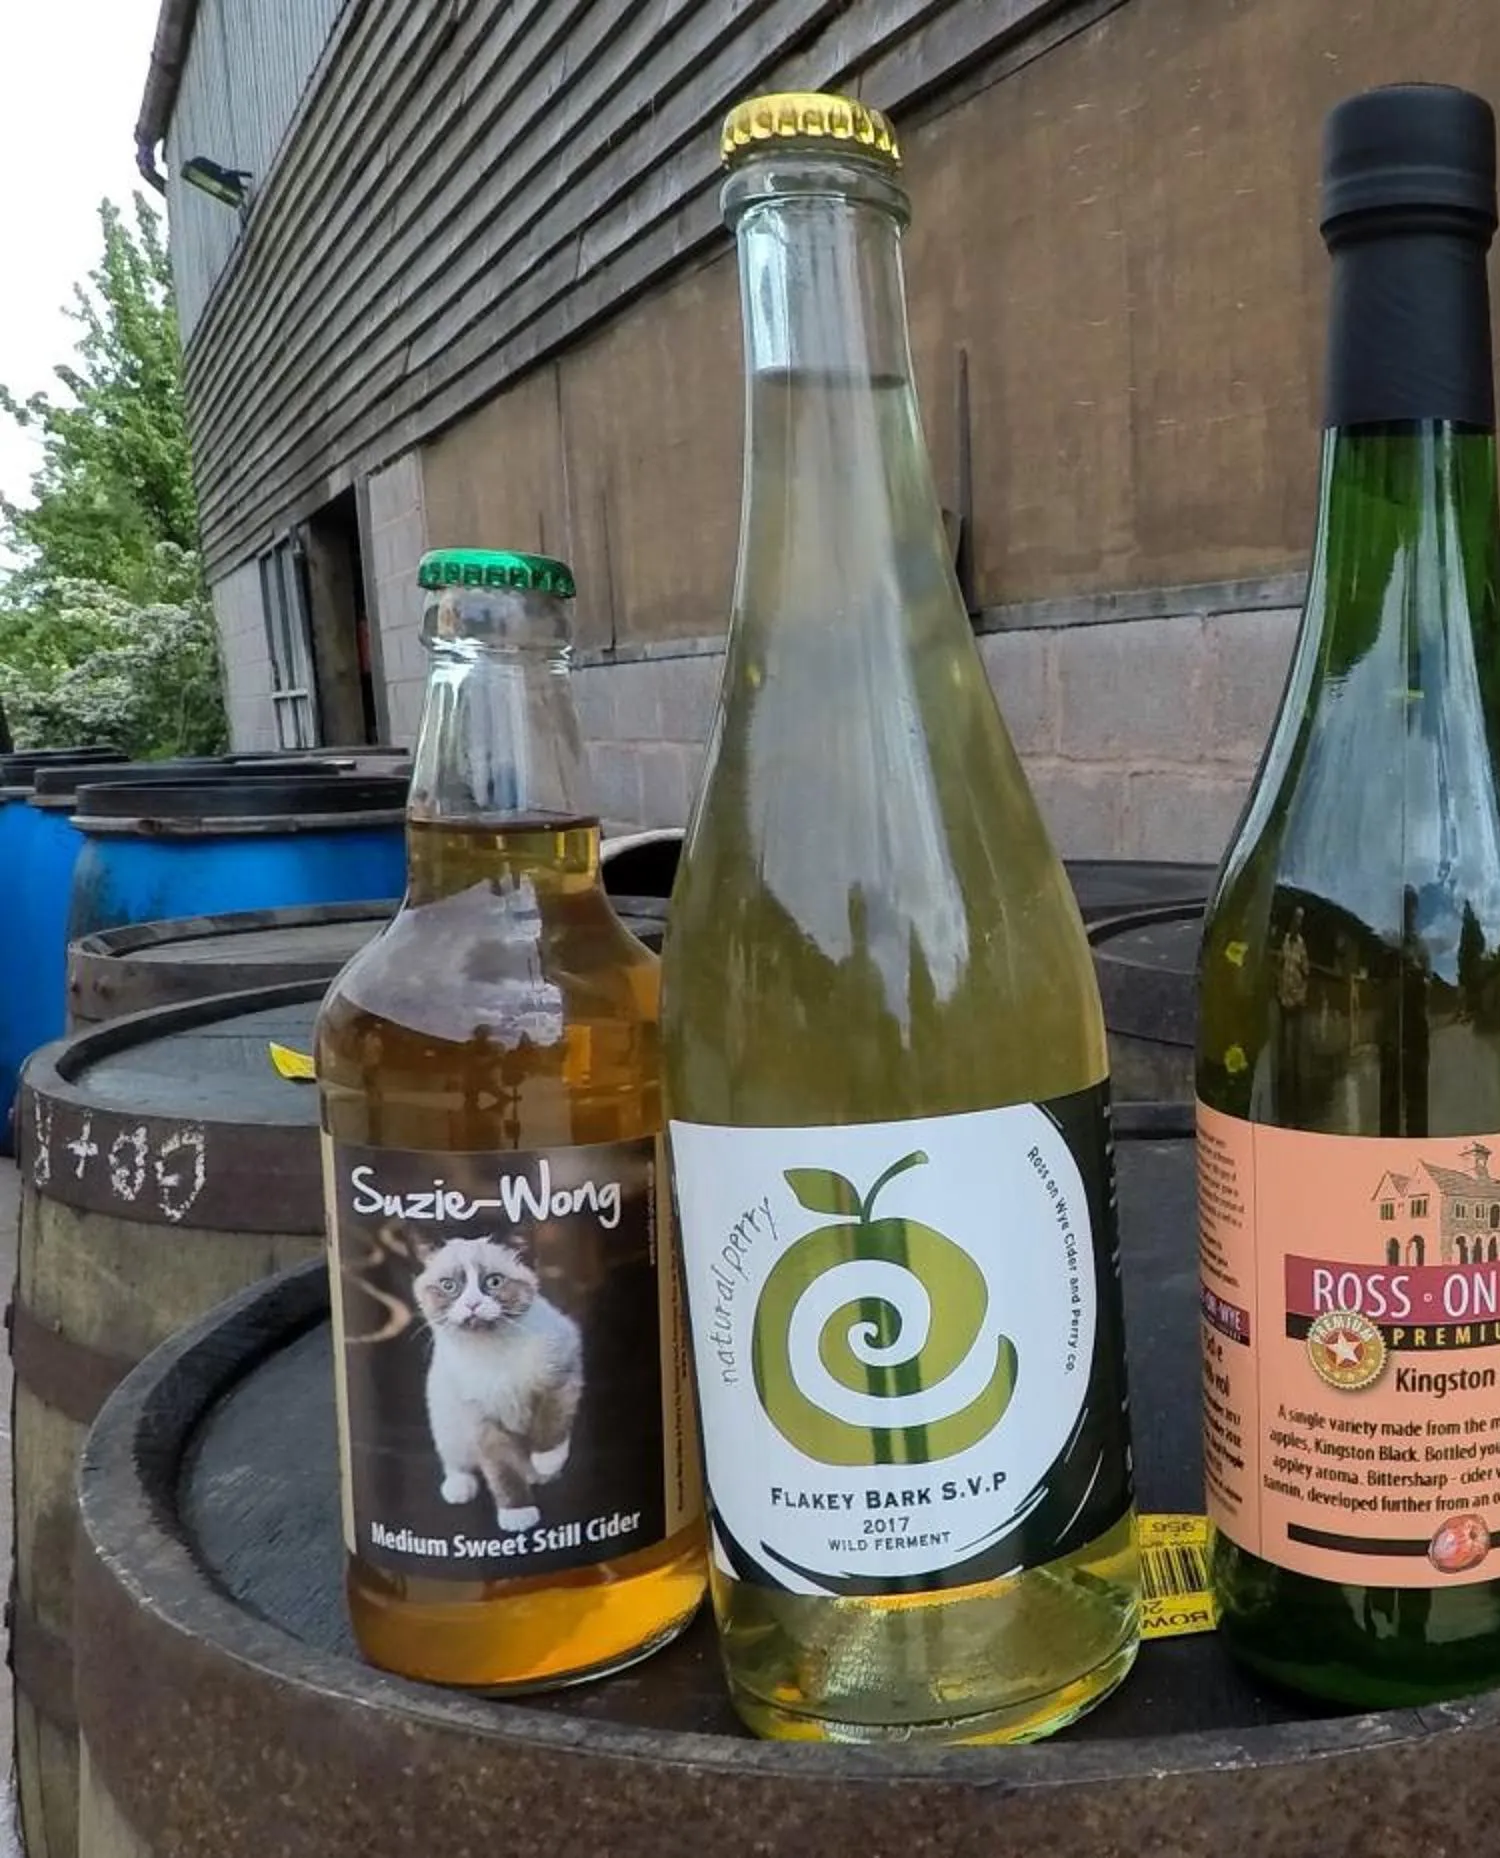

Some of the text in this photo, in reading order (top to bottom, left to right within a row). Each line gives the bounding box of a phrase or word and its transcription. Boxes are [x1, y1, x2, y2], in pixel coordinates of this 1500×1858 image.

[1026, 1145, 1050, 1180] Ross
[1045, 1179, 1059, 1199] on
[1054, 1199, 1071, 1231] Wye
[1063, 1230, 1077, 1274] Cider
[704, 1196, 778, 1387] natural perry
[1069, 1277, 1080, 1306] and
[1312, 1268, 1412, 1318] ROSS
[1442, 1270, 1497, 1318] ON
[1067, 1309, 1082, 1350] Perry
[1395, 1365, 1495, 1397] Kingston
[1278, 1404, 1286, 1419] A
[1289, 1409, 1325, 1430] single
[1329, 1418, 1378, 1439] variety
[1381, 1421, 1422, 1436] made
[1426, 1420, 1461, 1436] from
[1464, 1418, 1487, 1433] the
[1269, 1430, 1311, 1453] apples,
[1314, 1438, 1375, 1461] Kingston
[1379, 1446, 1420, 1462] Black.
[1425, 1442, 1477, 1461] Bottled
[942, 1472, 1008, 1501] S.V.P
[1263, 1474, 1305, 1500] tannin,
[1307, 1487, 1378, 1512] developed
[1381, 1496, 1432, 1512] further
[1436, 1496, 1470, 1511] from
[1472, 1494, 1490, 1507] an
[1316, 1467, 1363, 1485] aroma.
[1367, 1470, 1448, 1490] Bittersharp
[1460, 1467, 1493, 1485] cider
[371, 1509, 641, 1557] Medium Sweet Still Cider
[829, 1531, 951, 1552] WILD FERMENT
[863, 1517, 910, 1534] 2017
